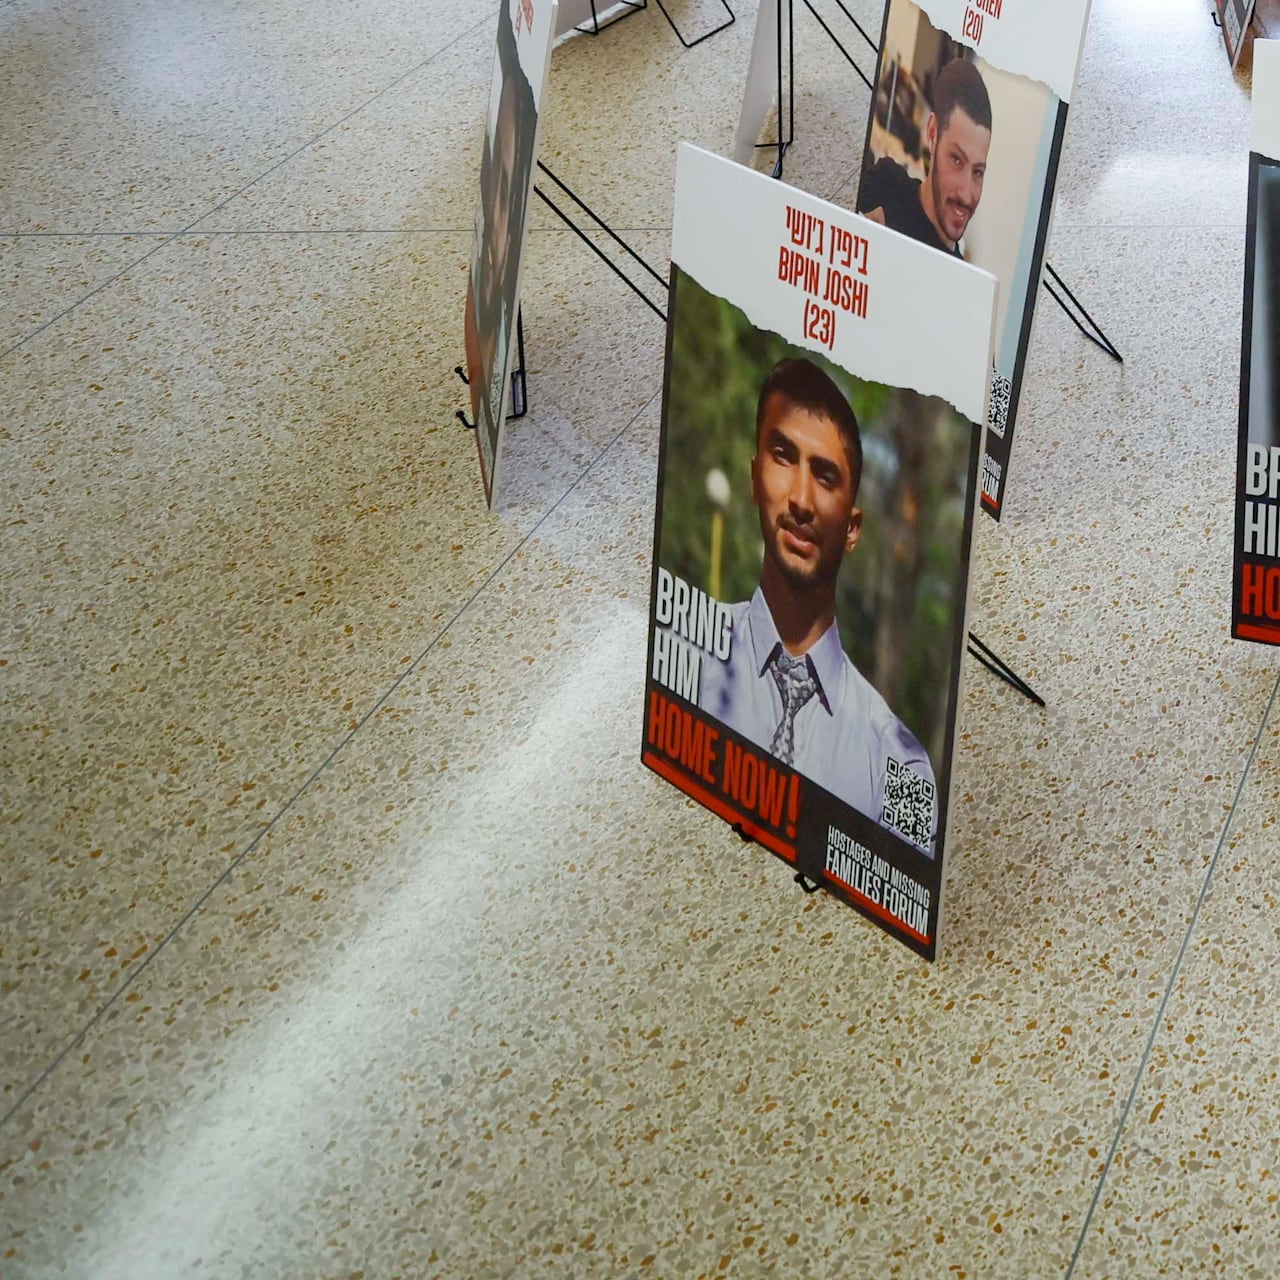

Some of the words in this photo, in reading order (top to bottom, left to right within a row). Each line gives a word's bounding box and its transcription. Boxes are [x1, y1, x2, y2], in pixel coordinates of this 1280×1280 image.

[962, 6, 985, 47] (20)
[778, 245, 821, 297] BIPIN
[823, 267, 869, 320] JOSHI
[829, 224, 870, 276] ביפין
[803, 298, 836, 352] (23)
[656, 566, 734, 662] BRING
[652, 626, 701, 707] HIM
[648, 690, 720, 785] HOME
[722, 738, 801, 840] NOW!
[825, 844, 882, 905] FAMILIES
[882, 882, 930, 938] FORUM
[827, 824, 872, 869] HOSTAGES
[871, 854, 891, 881] AND
[890, 866, 931, 909] MISSING
